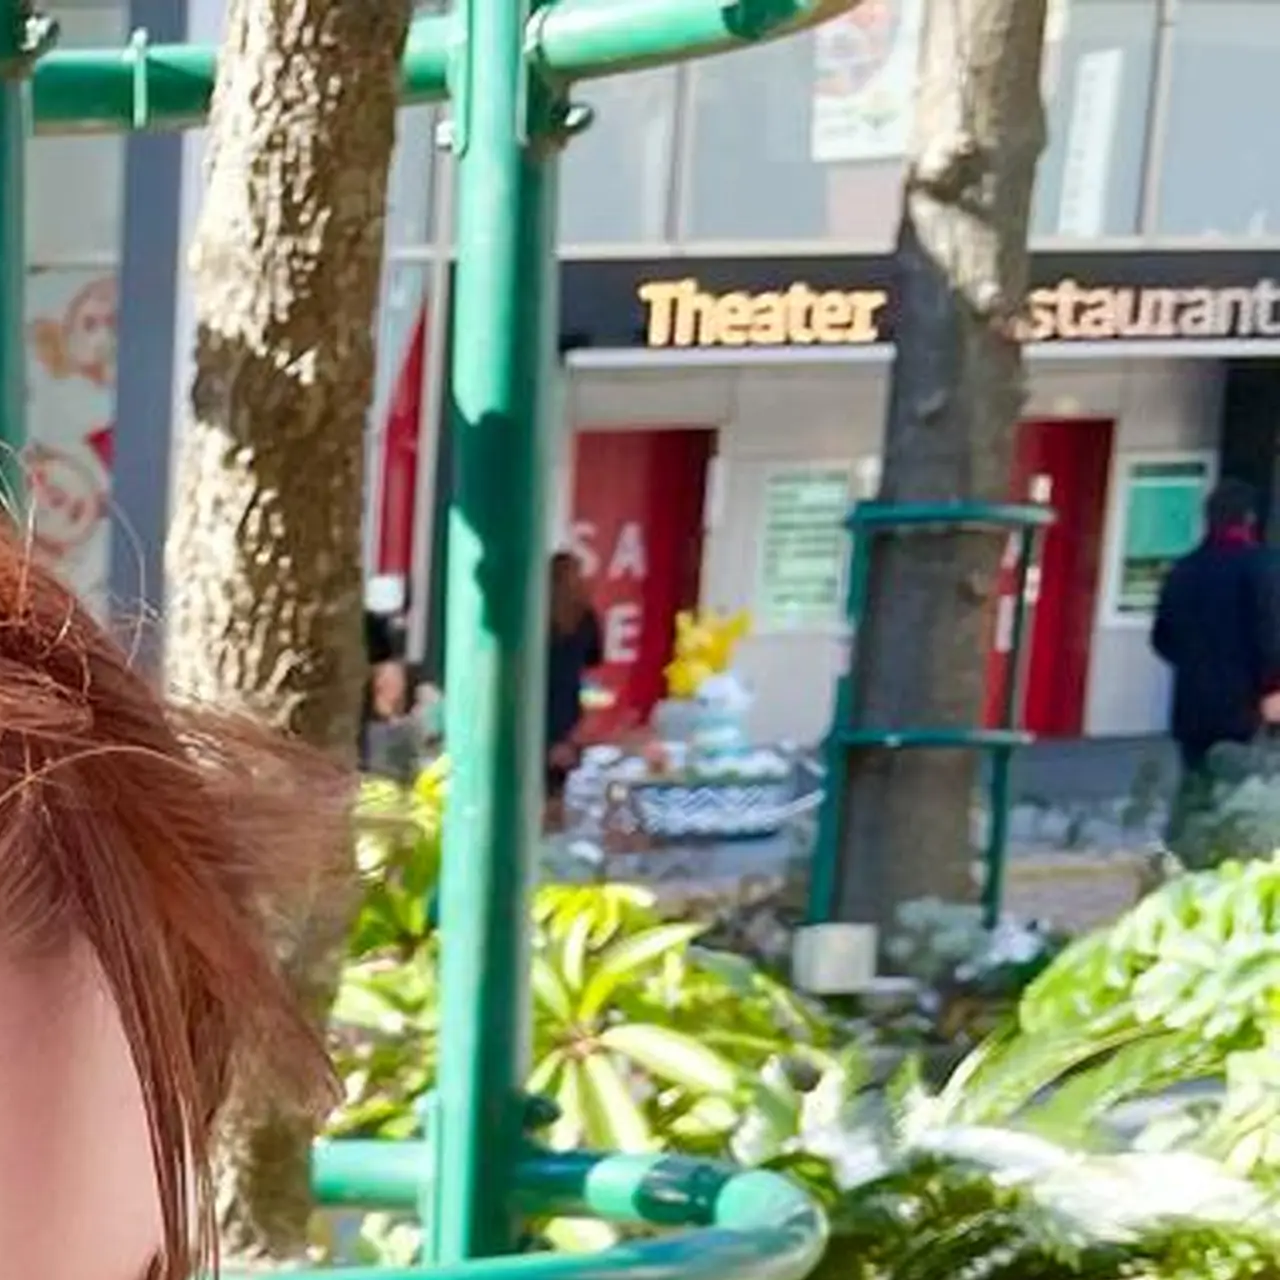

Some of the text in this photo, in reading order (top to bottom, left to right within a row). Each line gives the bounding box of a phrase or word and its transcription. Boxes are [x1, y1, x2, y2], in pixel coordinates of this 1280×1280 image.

[638, 278, 1280, 346] Theater staurant
[603, 602, 642, 663] E
